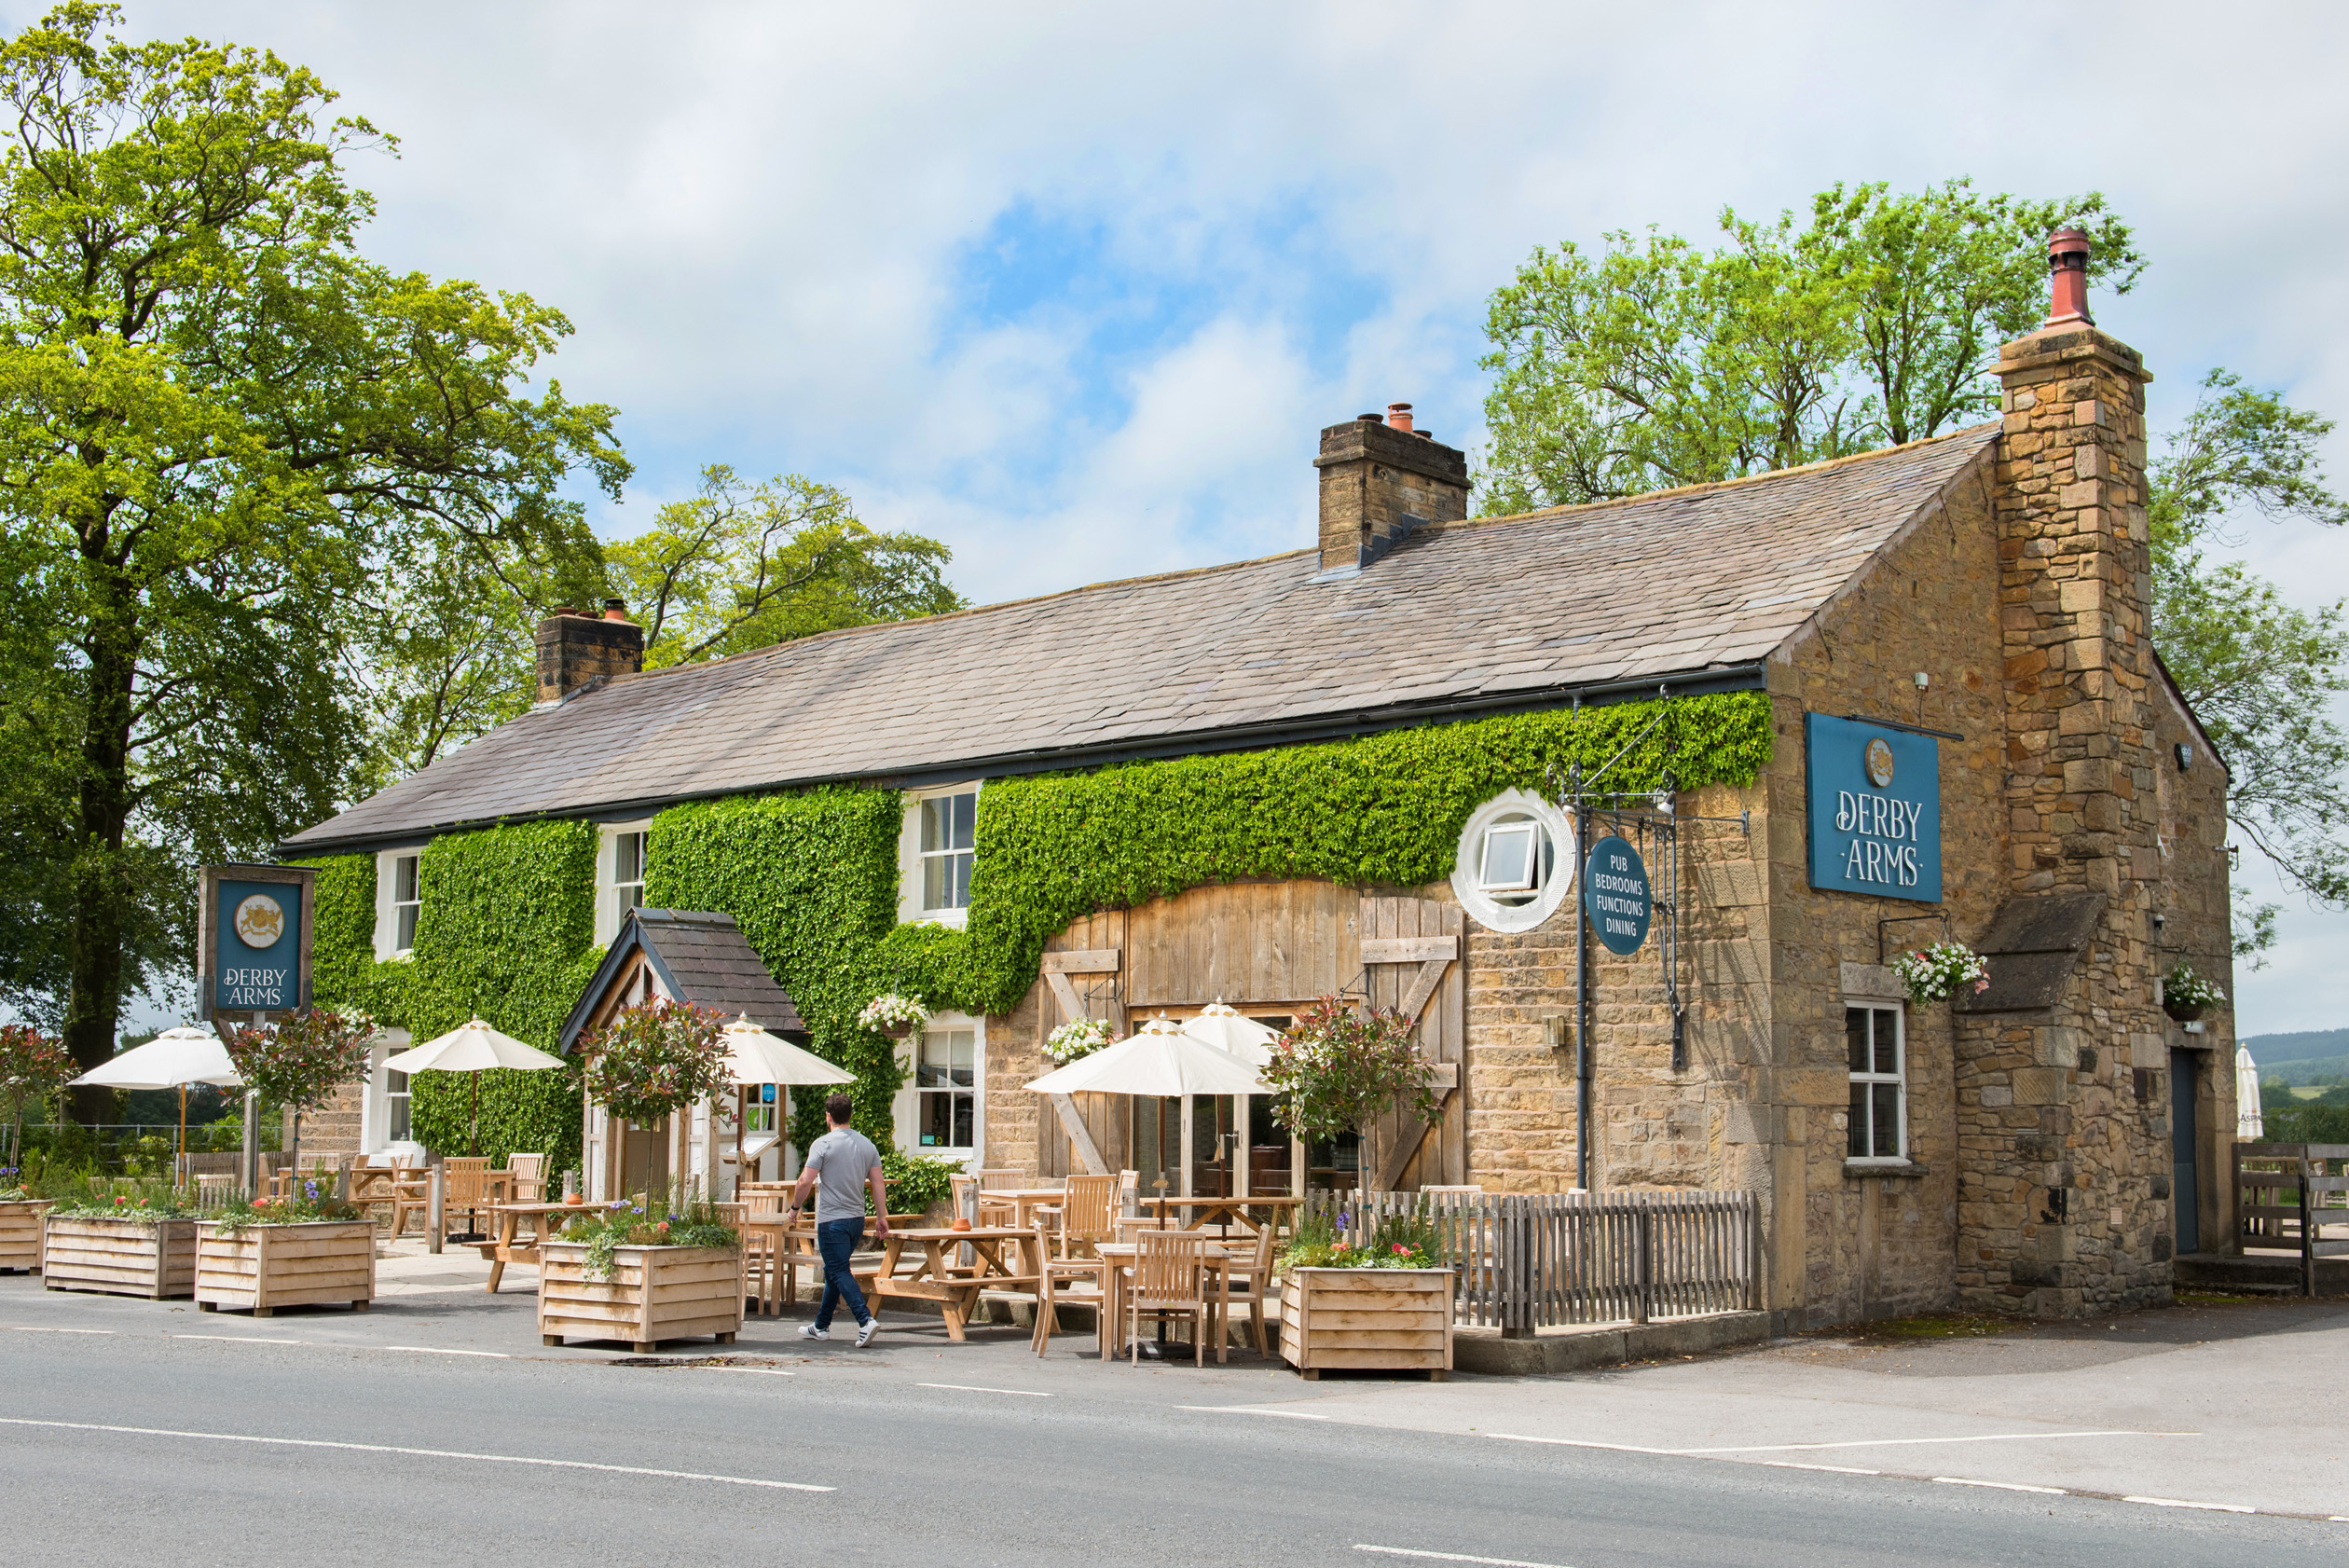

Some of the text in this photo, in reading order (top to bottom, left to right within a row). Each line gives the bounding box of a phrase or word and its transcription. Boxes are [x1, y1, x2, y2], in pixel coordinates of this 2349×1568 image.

[1836, 791, 1922, 841] DERBY
[1611, 855, 1628, 872] PUB
[1845, 839, 1917, 886] ARMS
[1596, 873, 1642, 895] BEDROOMS
[1597, 895, 1643, 916] FUNCTIONS
[1606, 918, 1637, 936] DINING
[224, 969, 287, 986] DERBY
[228, 988, 281, 1005] ARMS
